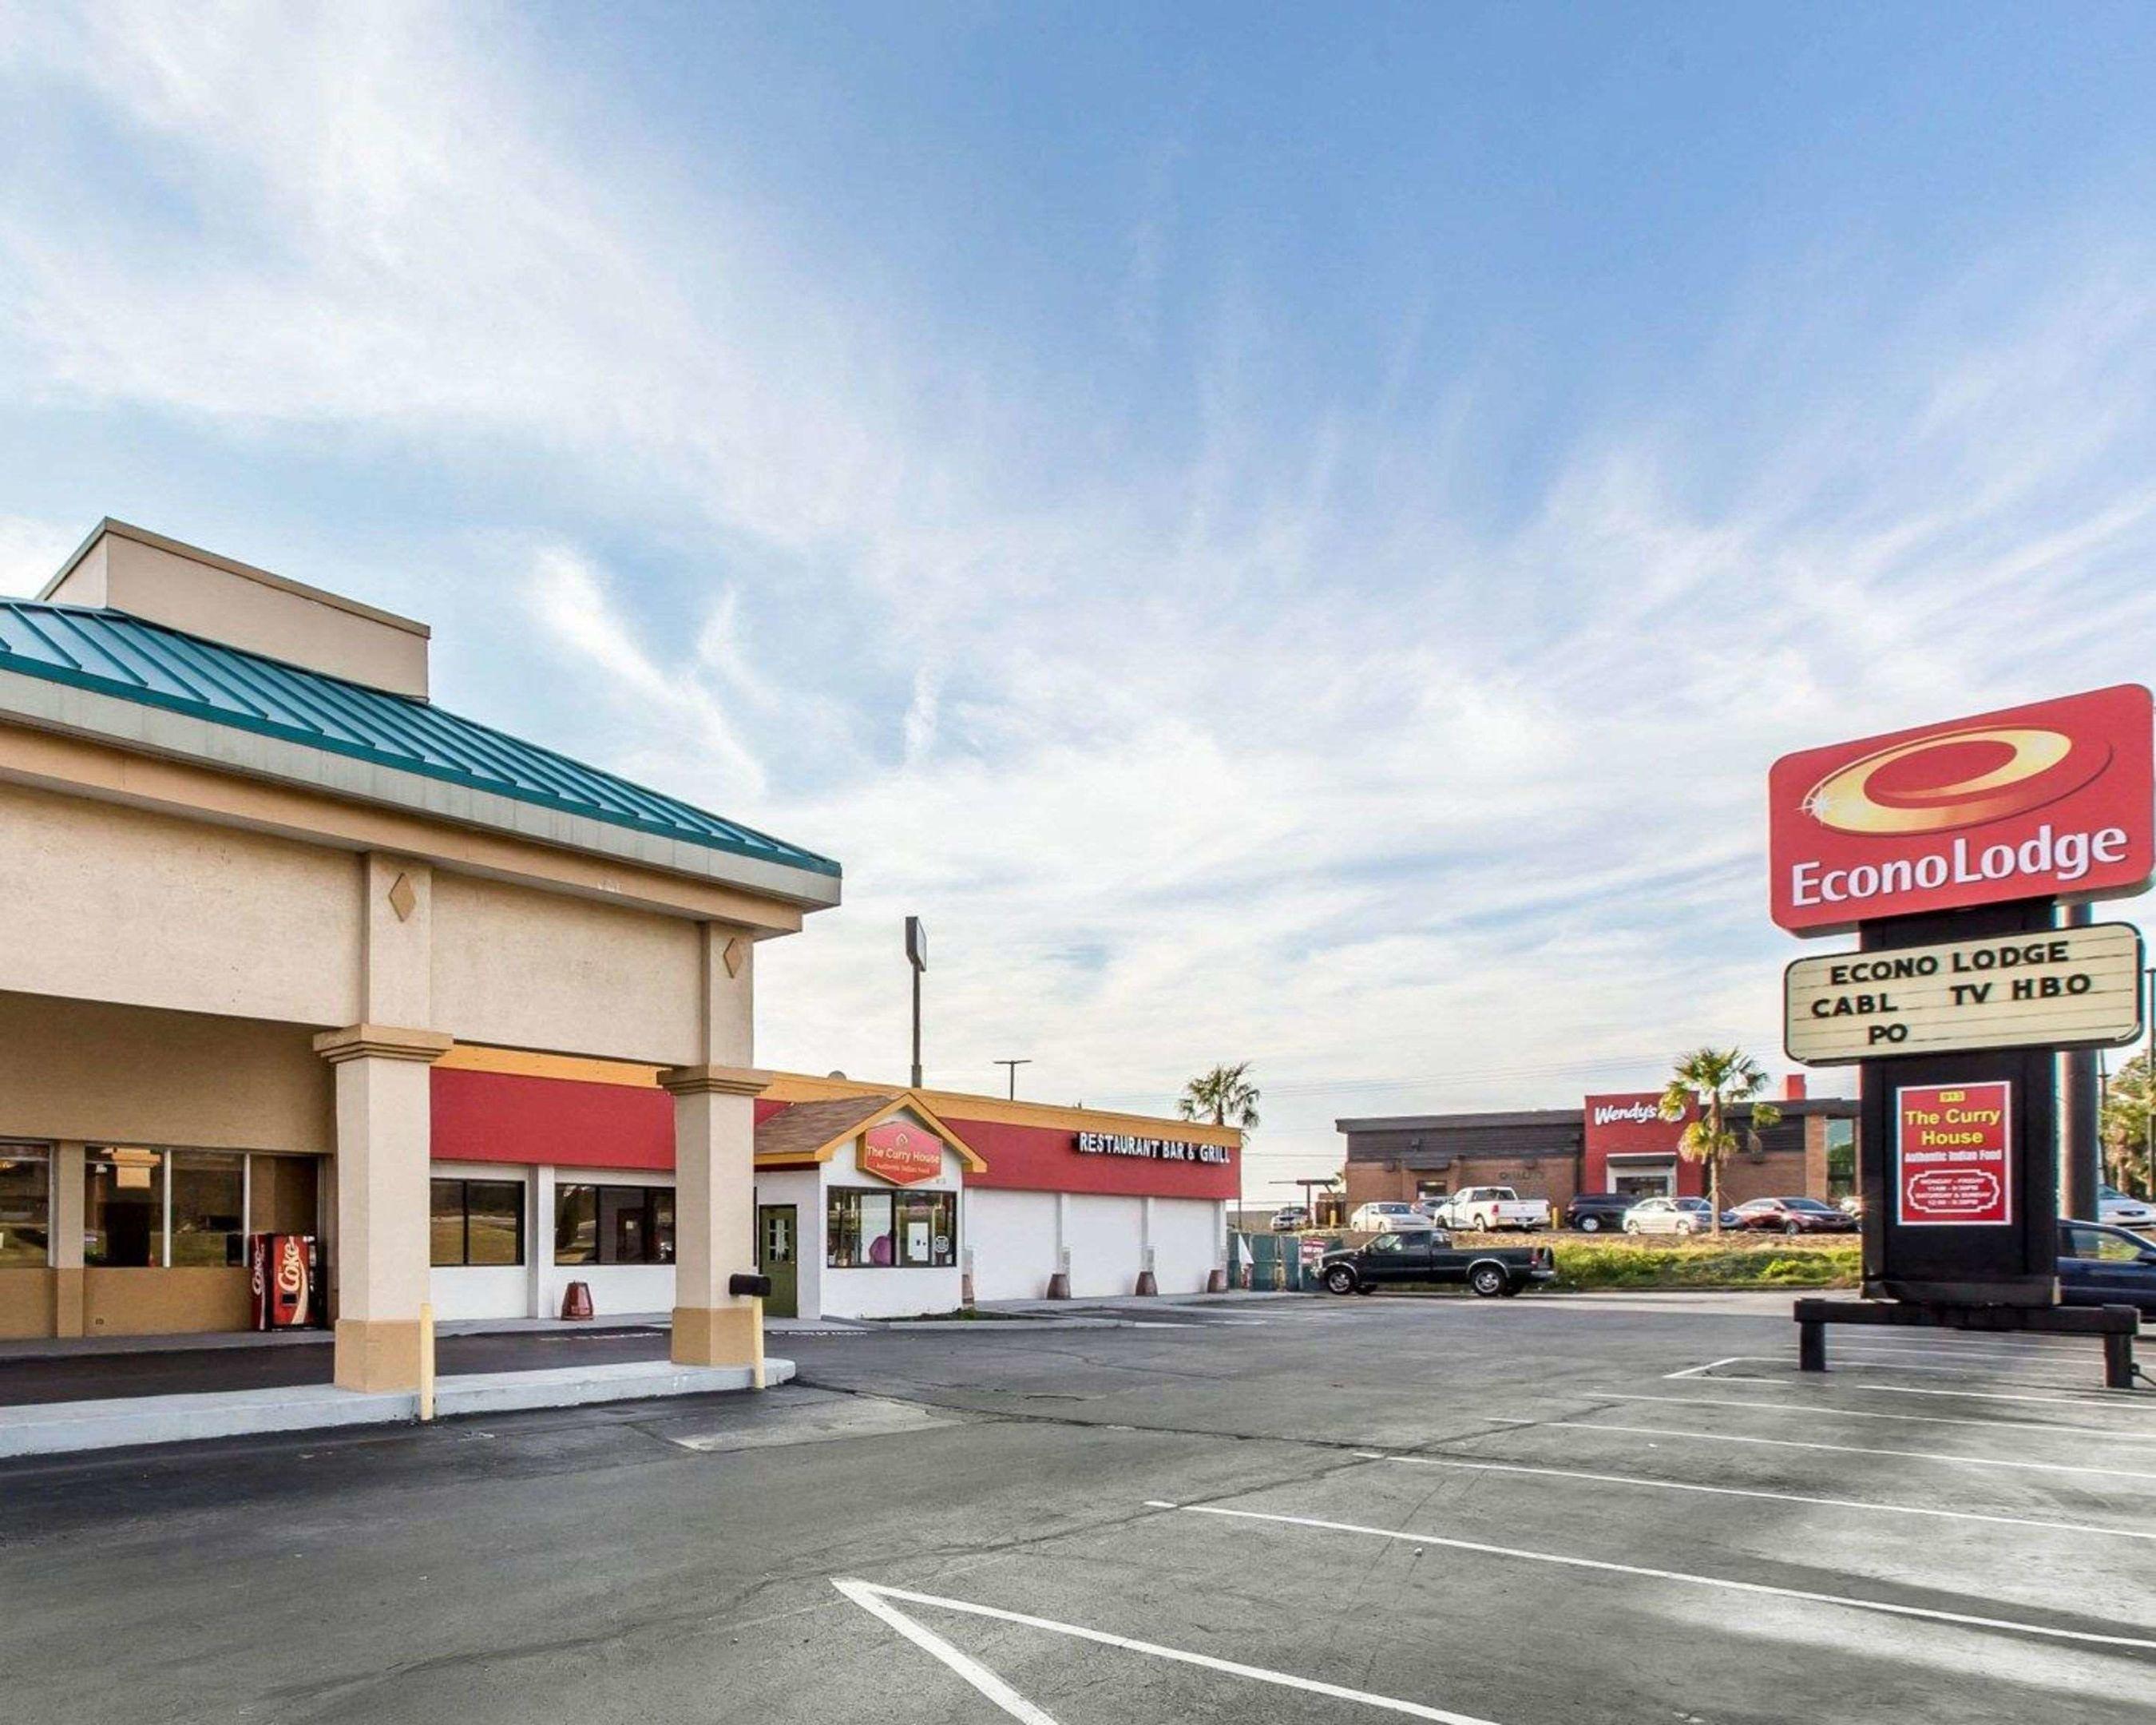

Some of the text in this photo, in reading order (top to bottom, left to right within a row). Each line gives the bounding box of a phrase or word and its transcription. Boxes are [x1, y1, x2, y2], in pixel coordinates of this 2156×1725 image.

[1830, 941, 2069, 985] ECONO LODGE
[1811, 974, 2091, 1018] CABL TV HBO
[1868, 1023, 1908, 1045] PO
[1595, 1102, 1657, 1125] Wendy's
[1904, 1108, 2001, 1126] The Curry
[1080, 1132, 1231, 1164] RESTAURANT BAR & GRILL
[1921, 1130, 1984, 1145] House
[866, 1146, 940, 1164] The Curry House
[278, 1243, 300, 1291] Coke
